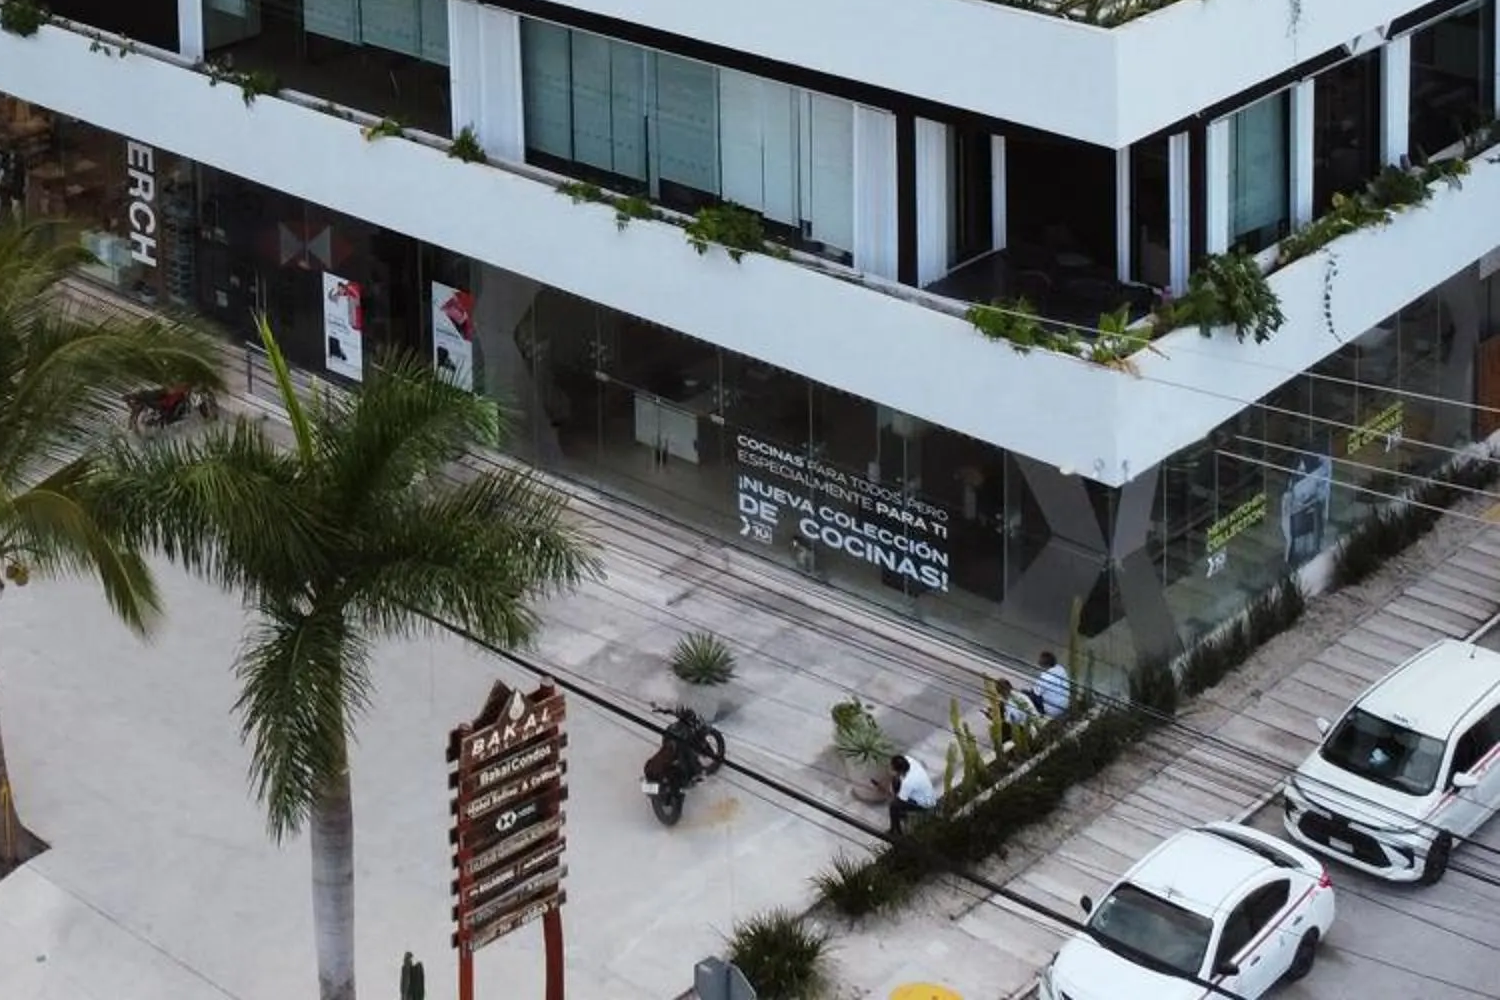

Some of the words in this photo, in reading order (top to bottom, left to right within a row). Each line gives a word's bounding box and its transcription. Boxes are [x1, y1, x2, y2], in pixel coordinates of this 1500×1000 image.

[736, 434, 805, 469] COCINAS
[806, 460, 848, 486] PARA
[736, 449, 874, 512] ESPECIALMENTE
[875, 501, 928, 532] PARA
[931, 520, 948, 539] TI
[739, 492, 779, 526] DE
[799, 517, 949, 593] COCINAS!
[818, 506, 949, 568] COLECCIÓN
[471, 705, 551, 757] BAKAL
